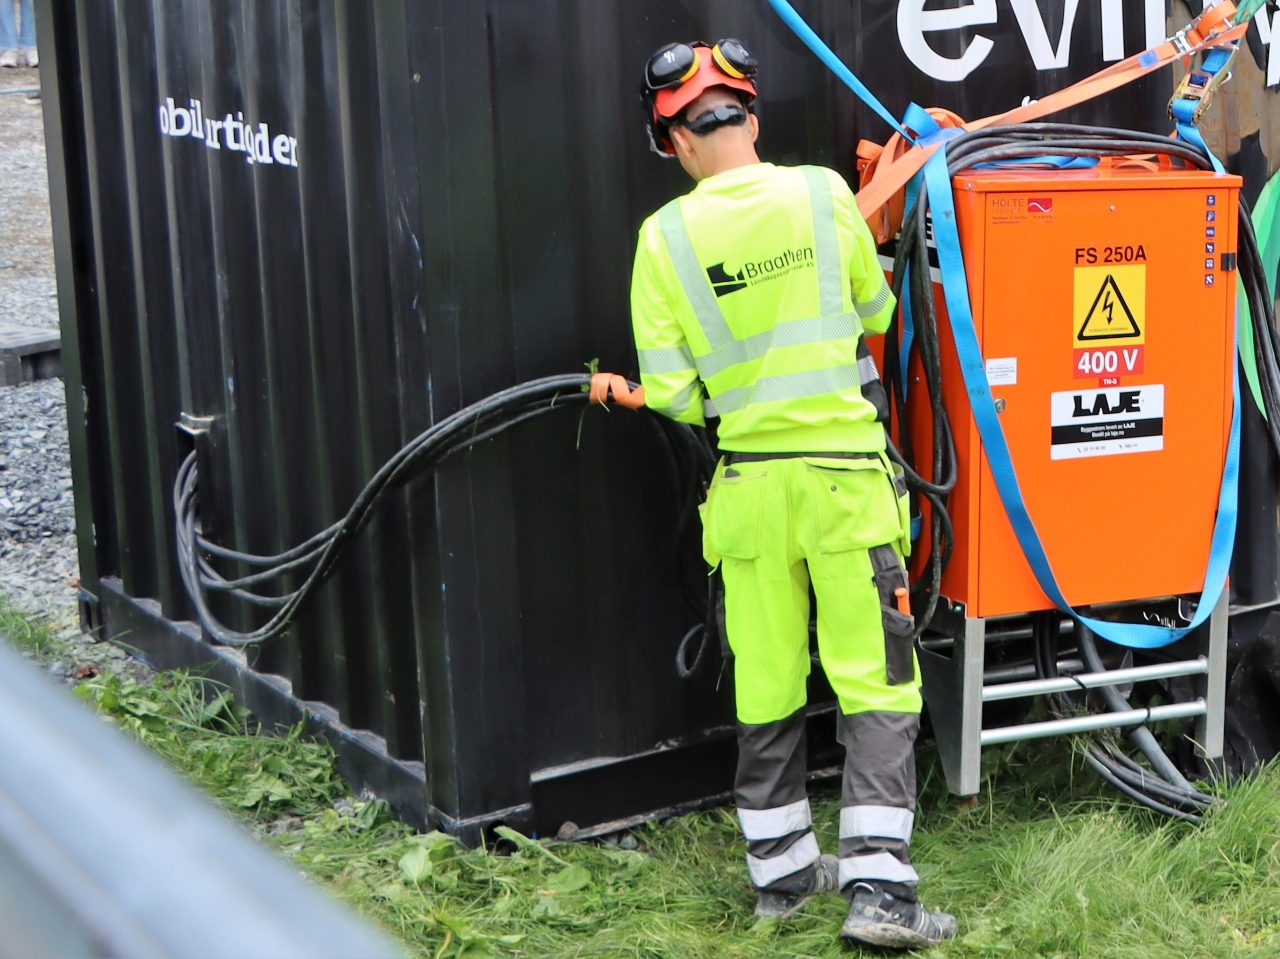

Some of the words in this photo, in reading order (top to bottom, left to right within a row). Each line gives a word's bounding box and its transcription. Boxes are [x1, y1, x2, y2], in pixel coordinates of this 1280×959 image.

[744, 247, 813, 279] Braathen
[1075, 247, 1098, 264] FS
[1103, 245, 1147, 262] 250A
[1077, 350, 1118, 374] 400
[1122, 348, 1139, 371] V
[1072, 390, 1141, 418] LAJE
